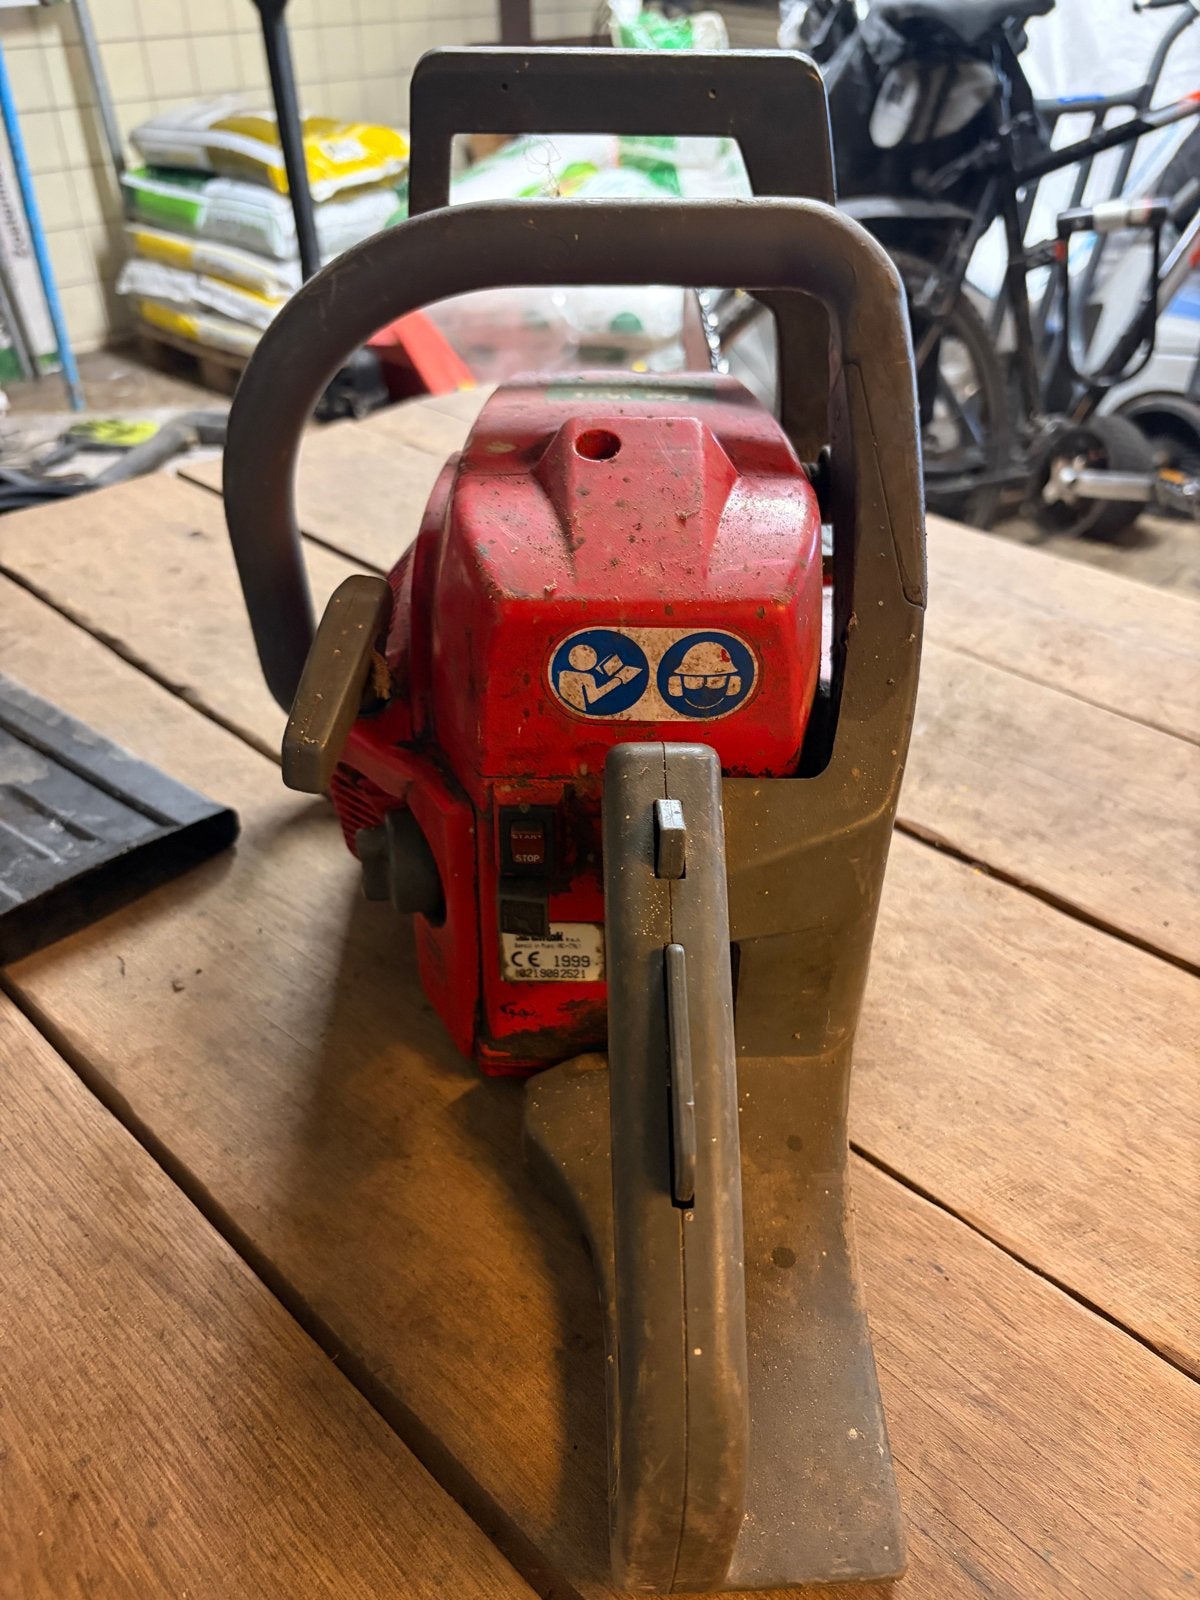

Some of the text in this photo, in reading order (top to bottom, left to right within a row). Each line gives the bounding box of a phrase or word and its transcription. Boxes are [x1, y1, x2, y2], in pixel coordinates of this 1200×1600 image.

[515, 854, 541, 863] STOP
[511, 951, 591, 968] CE 1999
